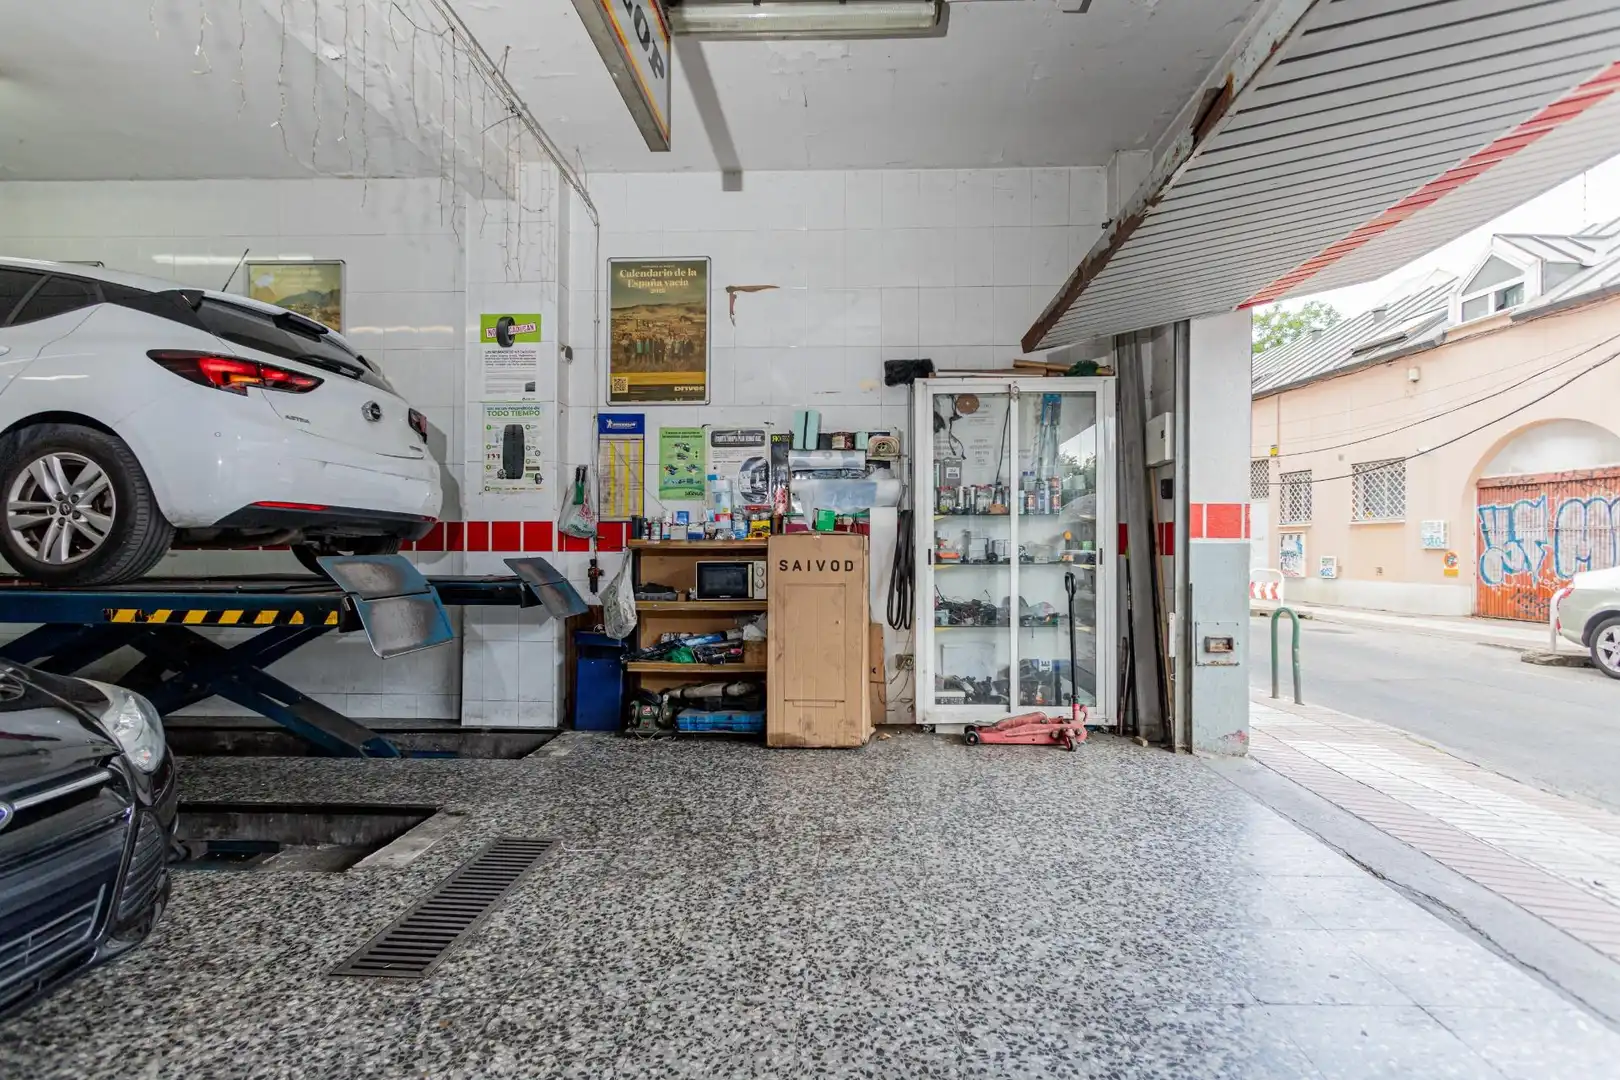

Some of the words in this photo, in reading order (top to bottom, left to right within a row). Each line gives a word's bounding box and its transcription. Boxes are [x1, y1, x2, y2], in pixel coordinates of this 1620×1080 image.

[620, 268, 673, 278] Calendario
[674, 268, 686, 277] de
[688, 267, 697, 277] la
[627, 279, 663, 289] España
[779, 559, 854, 572] SAIVOD
